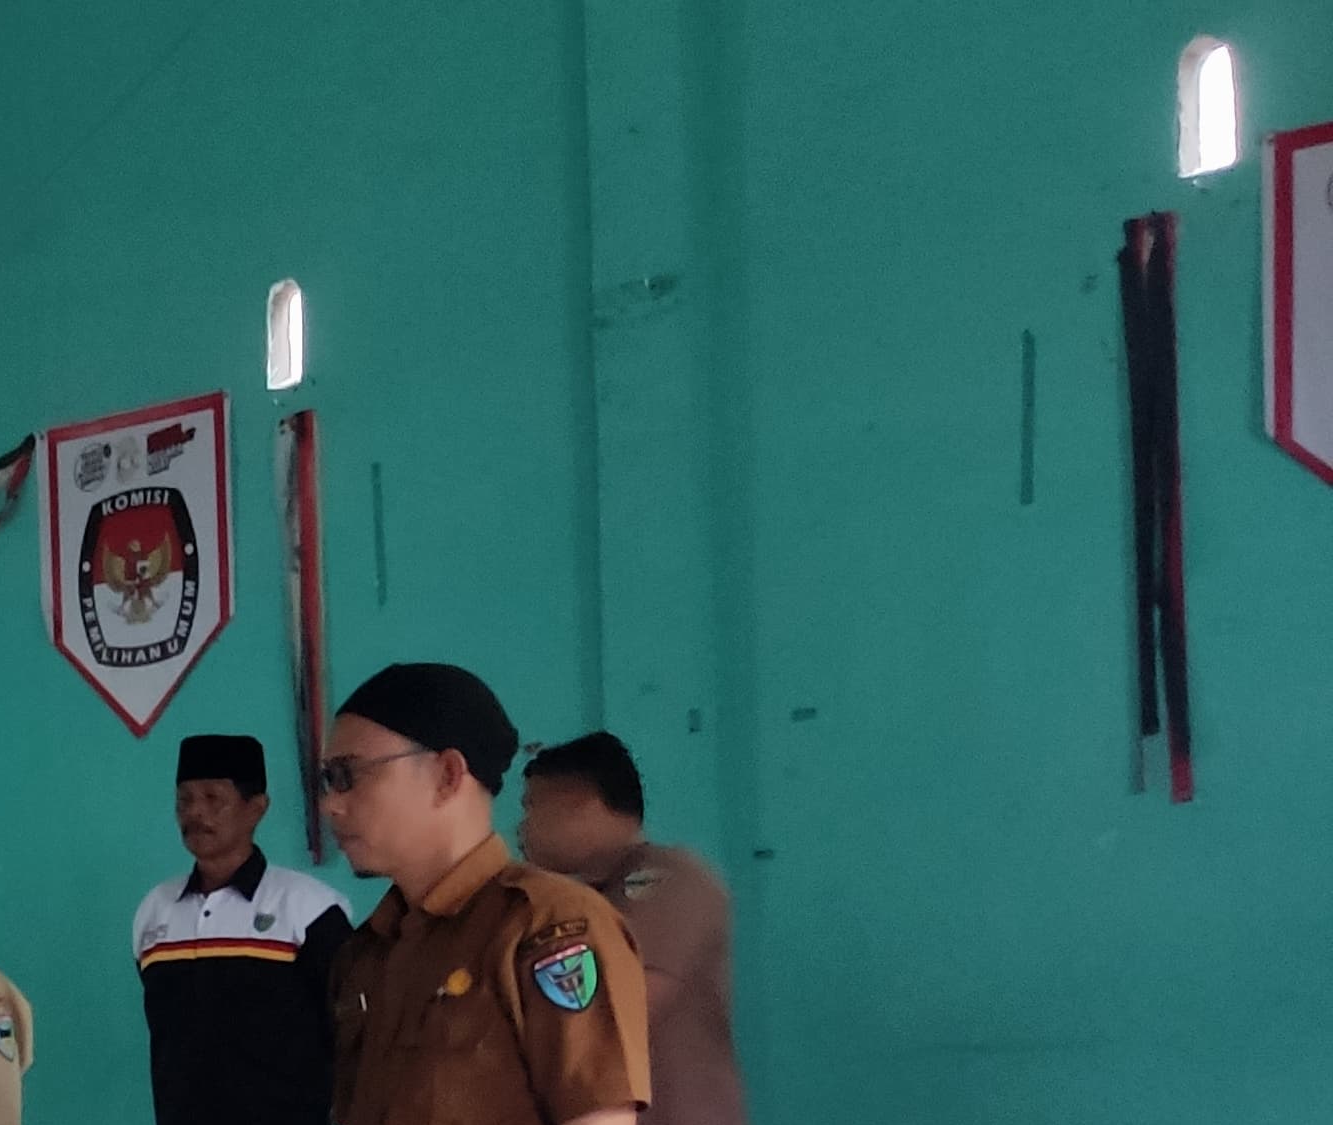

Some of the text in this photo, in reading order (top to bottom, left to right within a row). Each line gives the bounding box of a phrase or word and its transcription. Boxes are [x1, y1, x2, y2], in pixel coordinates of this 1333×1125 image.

[102, 489, 169, 516] KOMISI
[82, 580, 196, 663] PEMILIHAN UMUM
